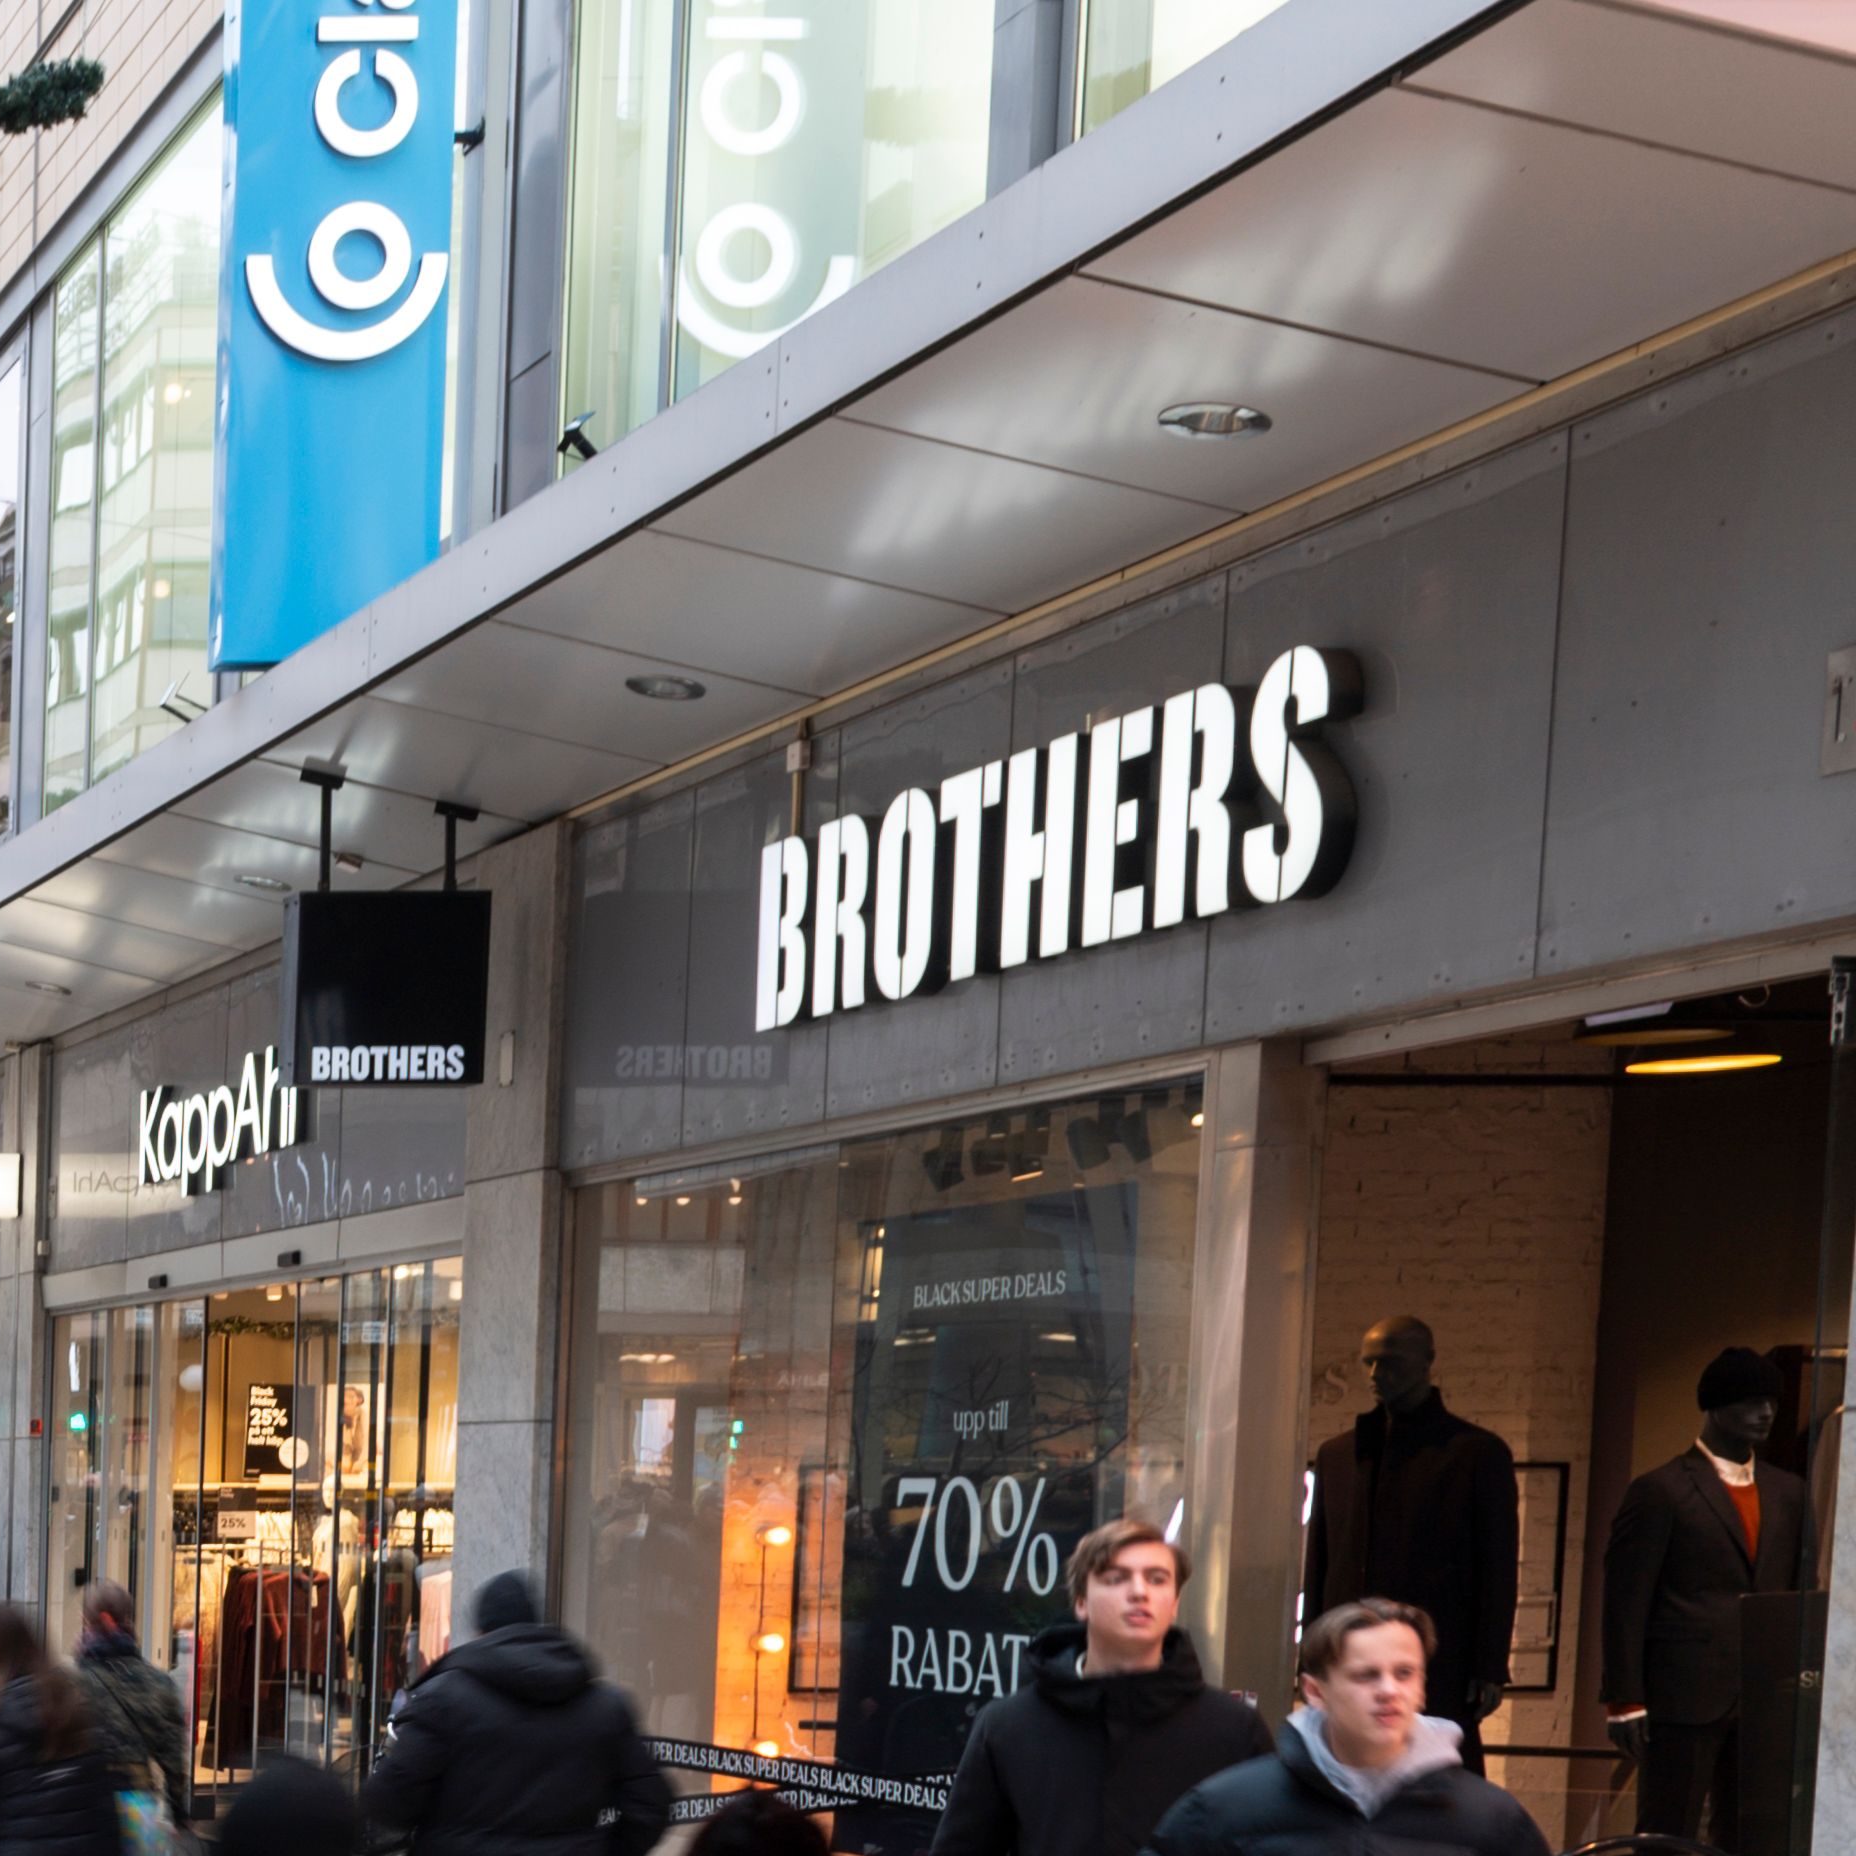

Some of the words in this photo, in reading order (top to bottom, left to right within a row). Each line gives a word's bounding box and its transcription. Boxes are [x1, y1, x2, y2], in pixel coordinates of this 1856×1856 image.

[756, 645, 1330, 1033] BROTHERS
[311, 1045, 466, 1081] BROTHERS
[913, 1281, 962, 1309] BLACK
[962, 1275, 1011, 1303] SUPER
[1014, 1270, 1067, 1298] DEALS
[250, 1408, 288, 1428] 25%
[953, 1410, 985, 1440] upp
[988, 1400, 1009, 1431] till
[221, 1517, 247, 1529] 25%
[897, 1475, 1059, 1596] 70%
[890, 1625, 1034, 1699] RABAT
[674, 1744, 707, 1768] DEALS
[708, 1749, 744, 1773] BLACK
[744, 1754, 780, 1780] SUPER
[781, 1761, 820, 1790] DEALS
[819, 1767, 861, 1796] BLACK
[861, 1775, 903, 1804] SUPER
[904, 1783, 948, 1812] DEALS
[669, 1802, 690, 1821] PER
